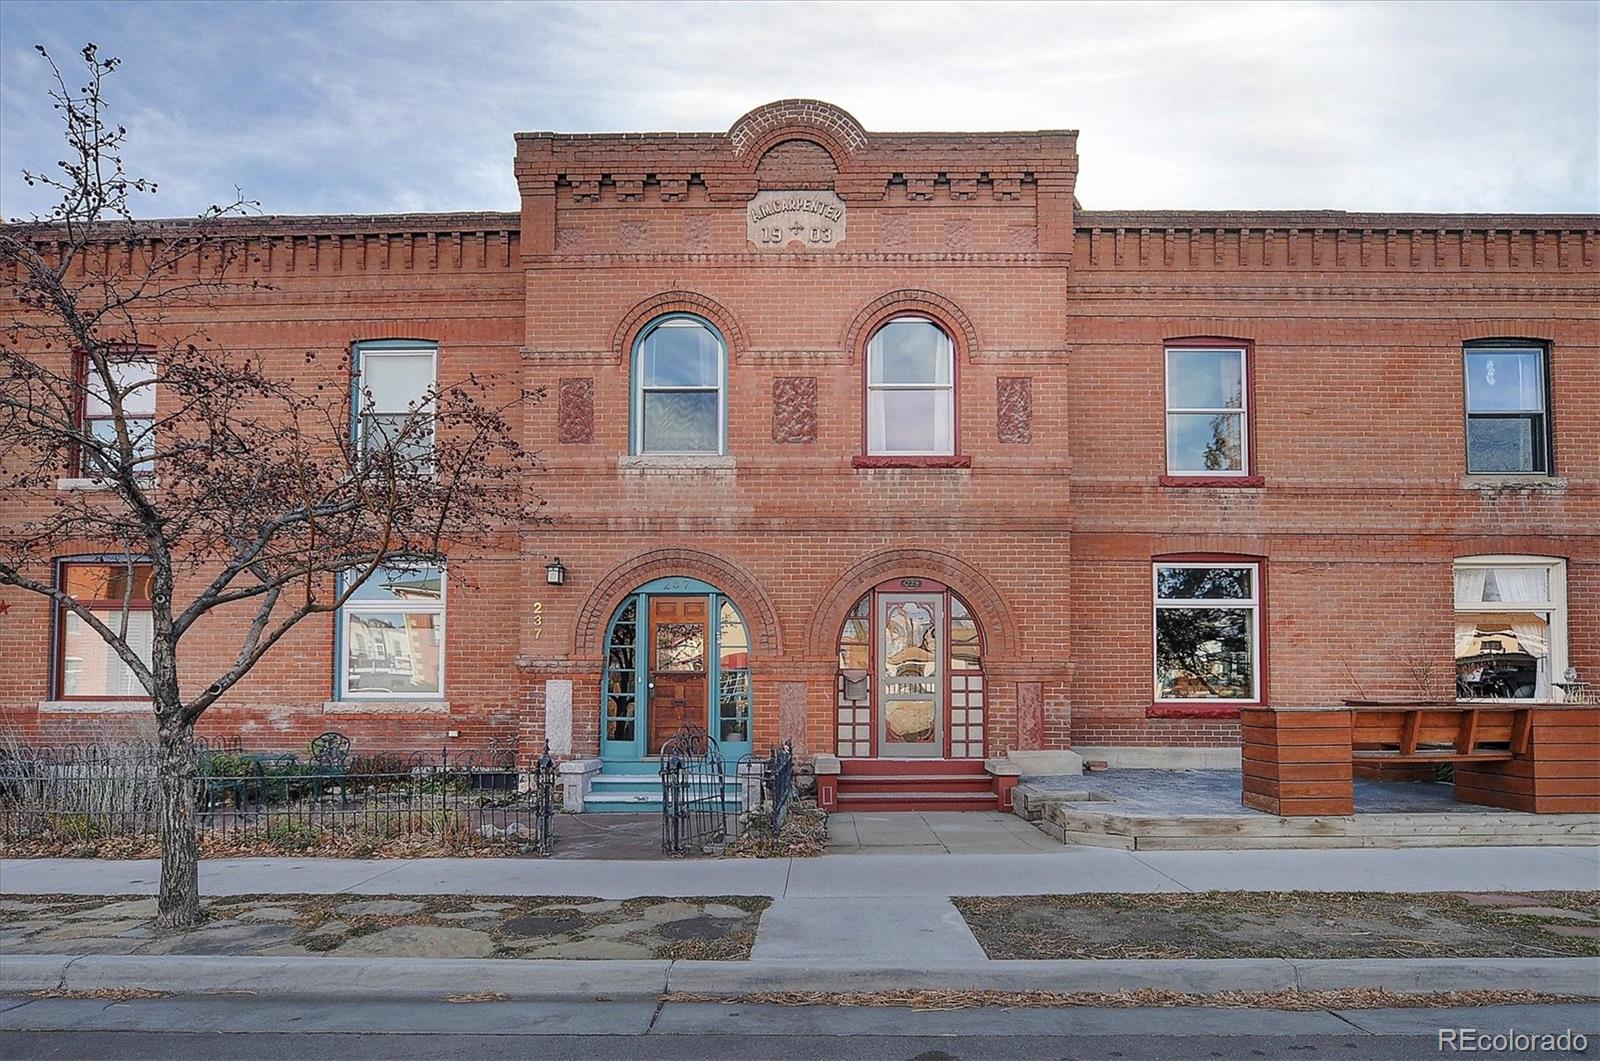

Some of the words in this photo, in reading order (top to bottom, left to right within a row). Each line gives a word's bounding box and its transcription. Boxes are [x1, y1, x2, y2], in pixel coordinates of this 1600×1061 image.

[762, 228, 783, 243] 19
[810, 228, 833, 243] 03
[533, 602, 543, 640] 237
